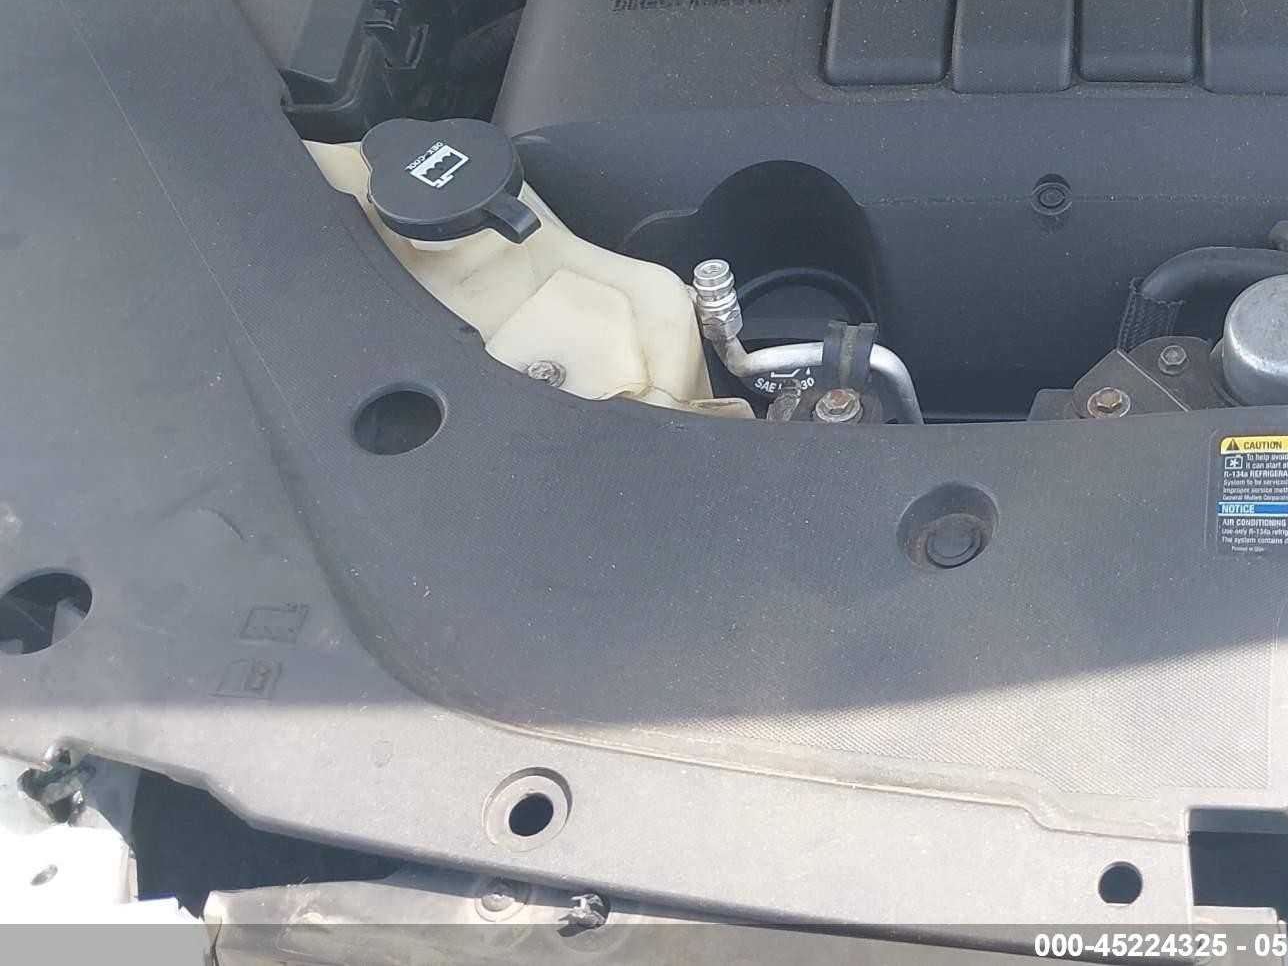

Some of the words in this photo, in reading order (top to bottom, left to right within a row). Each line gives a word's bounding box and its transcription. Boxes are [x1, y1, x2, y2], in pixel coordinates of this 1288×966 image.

[404, 141, 444, 171] DEX-COOL
[754, 378, 777, 393] SAE
[1243, 441, 1282, 450] CAUTION
[1256, 454, 1270, 462] help
[1222, 504, 1254, 513] NOTICE
[1236, 518, 1286, 526] CONDITIONING
